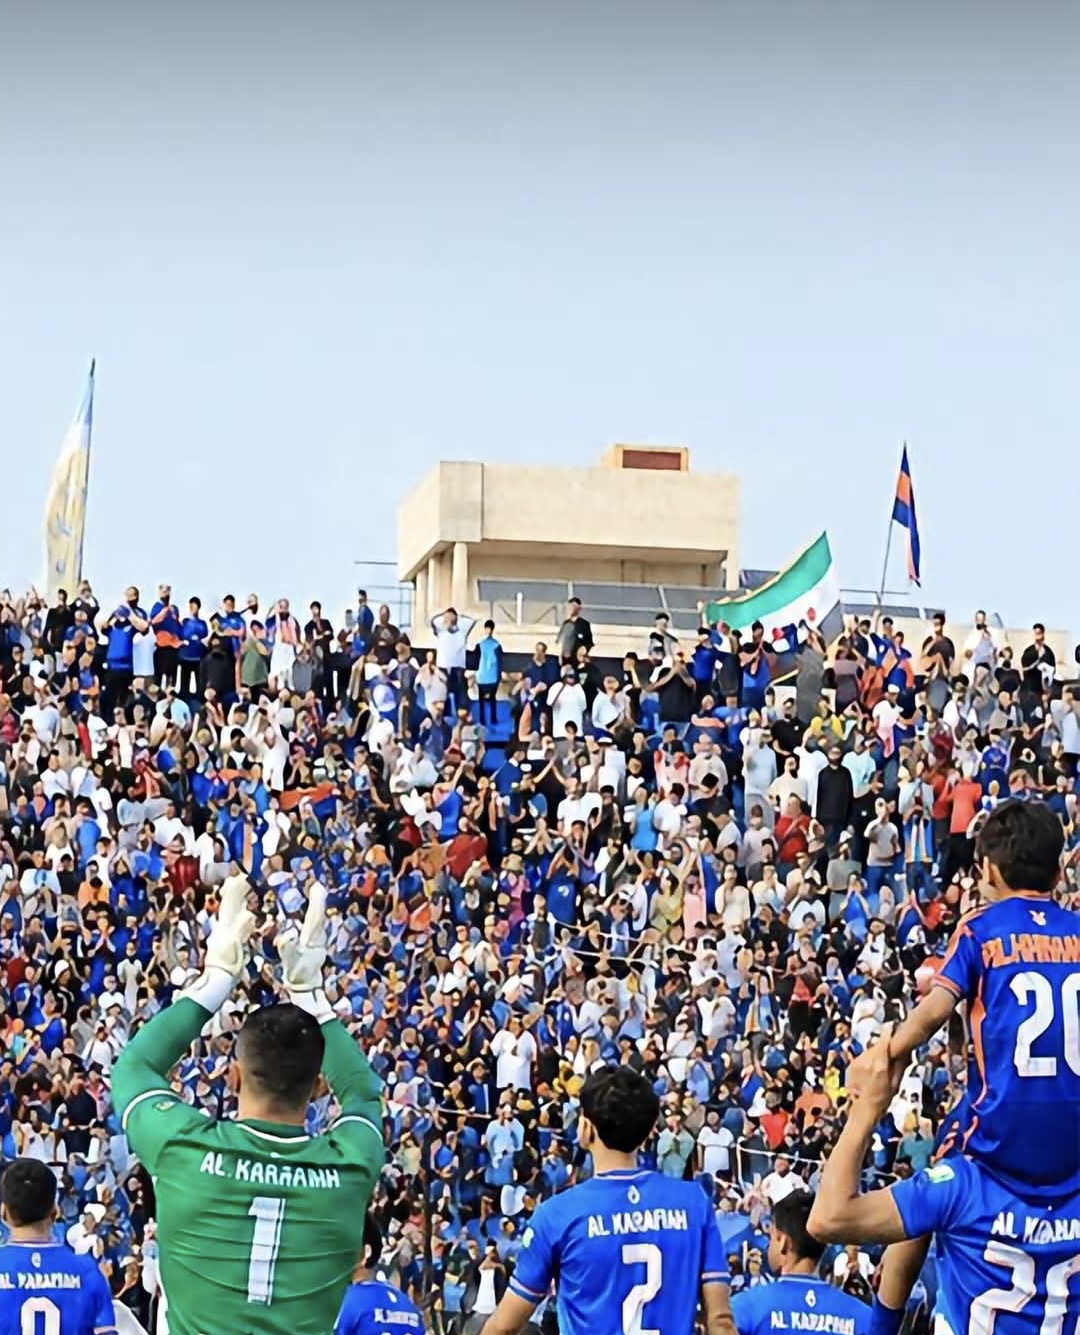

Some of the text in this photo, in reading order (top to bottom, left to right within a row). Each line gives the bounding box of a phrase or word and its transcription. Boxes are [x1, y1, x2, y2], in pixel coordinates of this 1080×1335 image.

[588, 1214, 610, 1238] AL
[991, 1211, 1018, 1239] AL
[247, 1197, 286, 1306] 1
